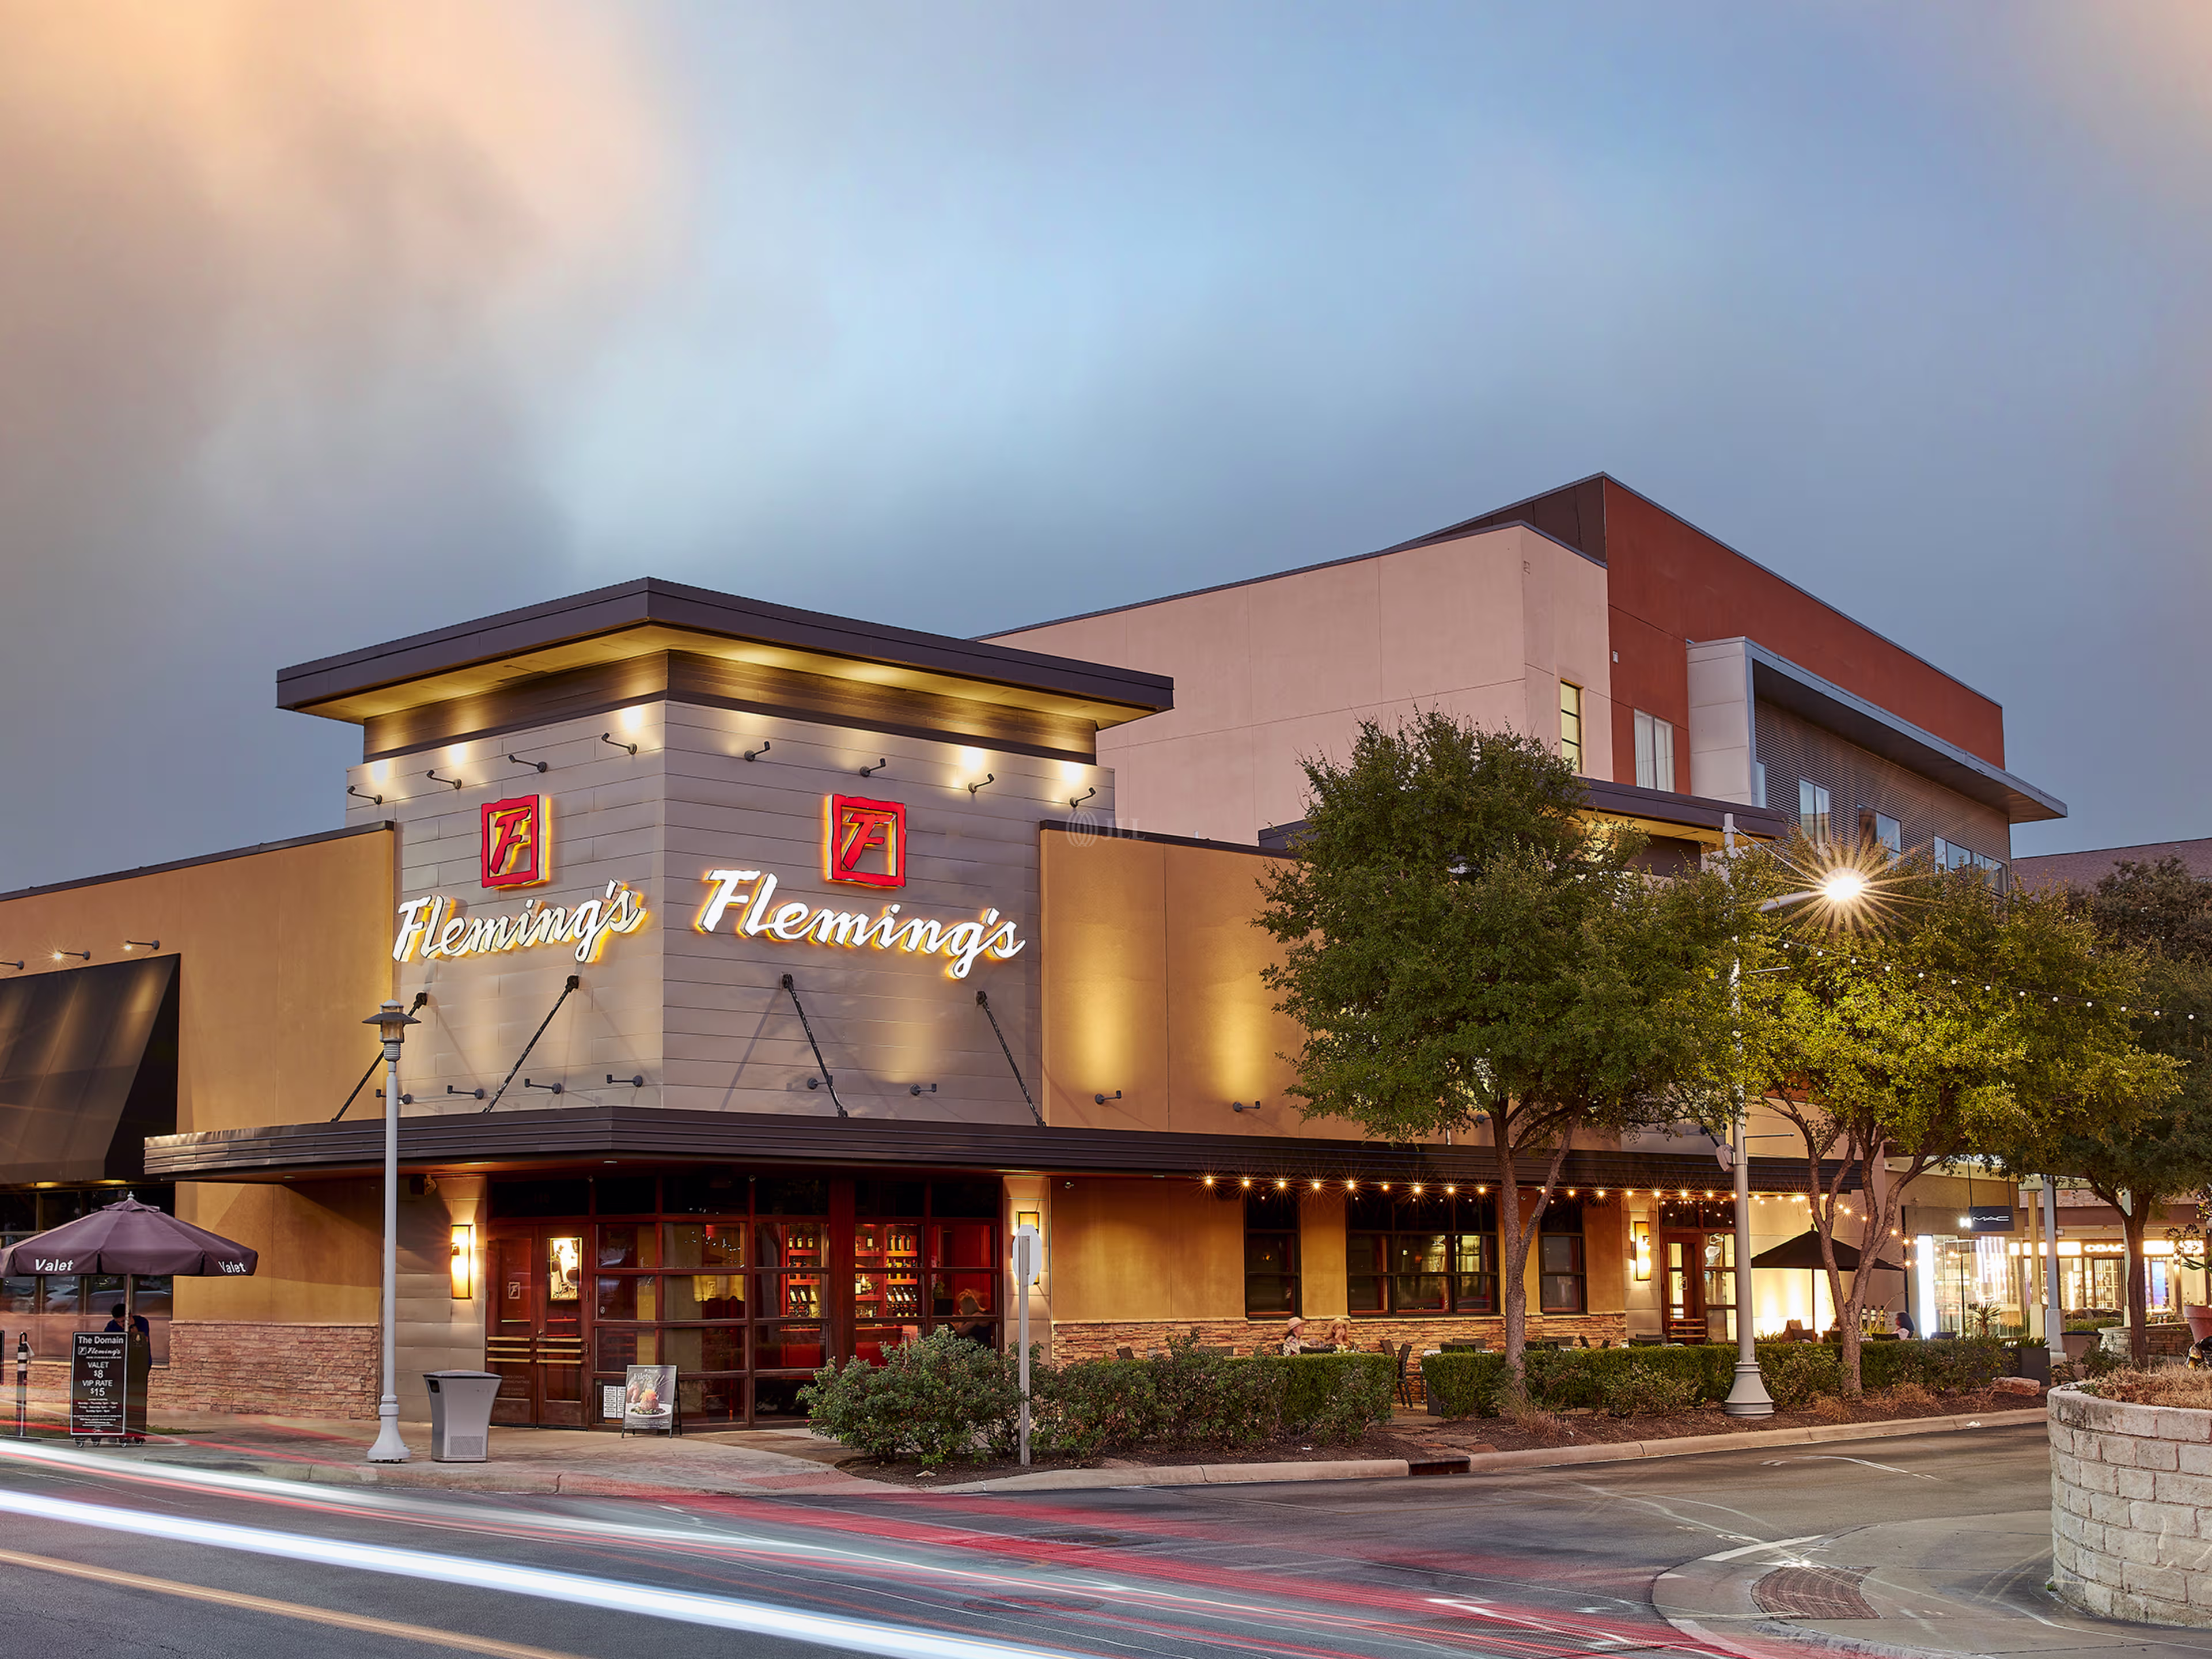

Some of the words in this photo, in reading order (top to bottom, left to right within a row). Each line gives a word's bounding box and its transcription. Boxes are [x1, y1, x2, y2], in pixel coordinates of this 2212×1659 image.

[392, 878, 646, 963] Fleming's
[696, 869, 1026, 979] Fleming's
[2084, 1244, 2125, 1252] COAC
[35, 1259, 74, 1271] Valet
[218, 1260, 247, 1273] Valet
[78, 1336, 92, 1344] The
[94, 1336, 124, 1344] Domain
[87, 1347, 122, 1356] Fleming's
[93, 1369, 104, 1378] $8
[90, 1388, 105, 1396] $15
